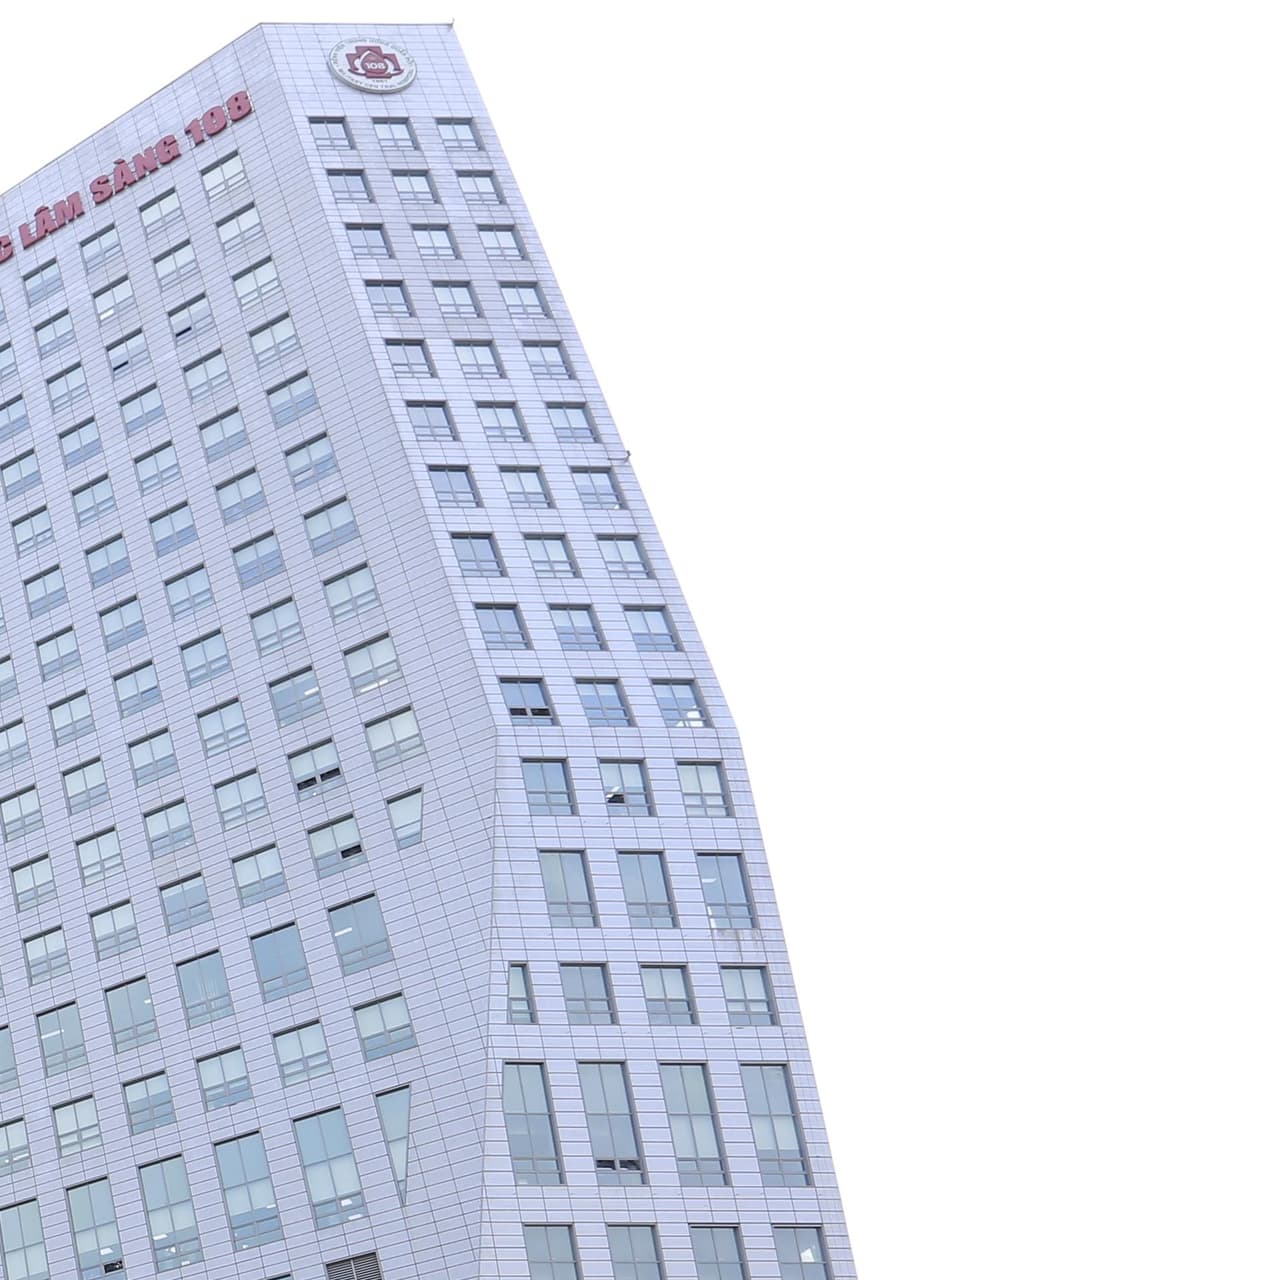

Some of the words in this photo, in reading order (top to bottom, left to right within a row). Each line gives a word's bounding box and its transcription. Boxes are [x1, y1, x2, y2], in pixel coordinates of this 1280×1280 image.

[18, 191, 85, 250] LÂM
[90, 135, 182, 205] SÀNG
[184, 90, 253, 147] 108
